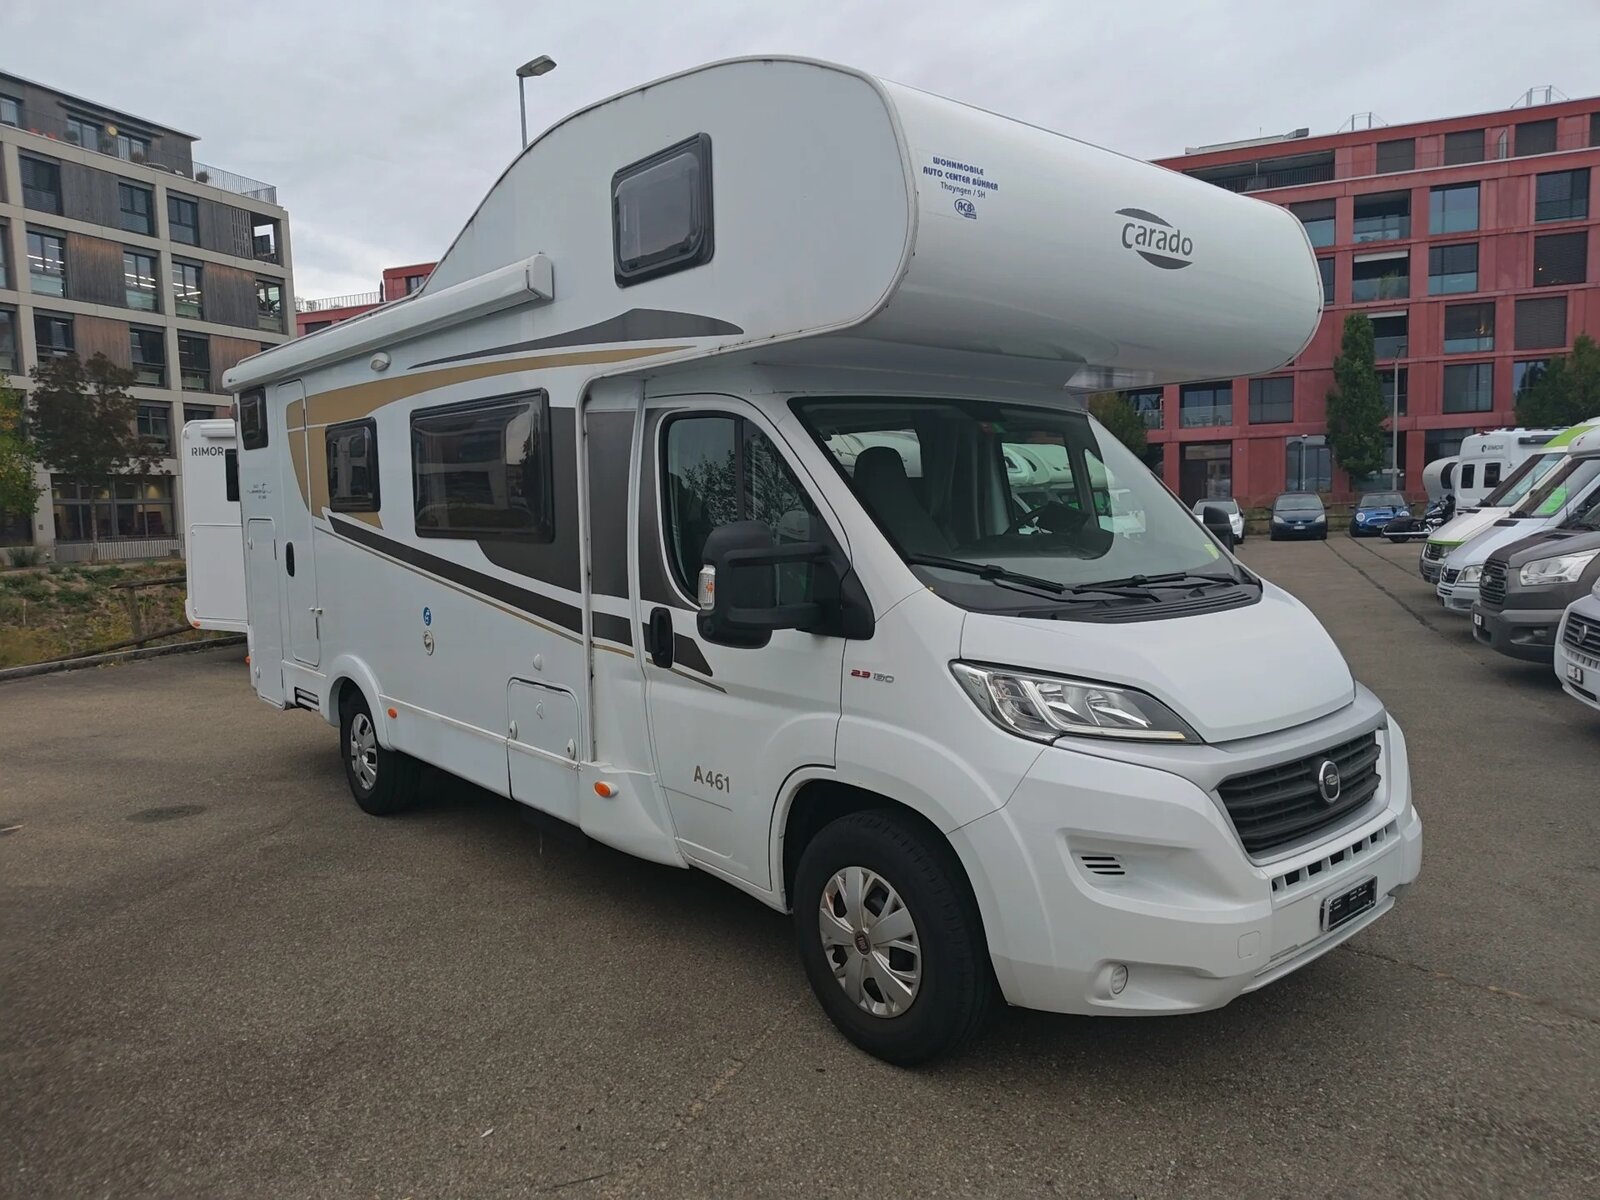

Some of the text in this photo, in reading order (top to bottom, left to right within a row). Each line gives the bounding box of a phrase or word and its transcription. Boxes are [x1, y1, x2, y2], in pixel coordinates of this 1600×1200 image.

[932, 156, 984, 176] WOHNMOBILE
[922, 166, 998, 191] AUTO CENTER BÜHRER
[940, 181, 972, 197] Thayngen
[977, 190, 986, 199] SH
[957, 201, 973, 213] ACB
[191, 446, 224, 457] RIMOR
[850, 669, 871, 679] 2.3
